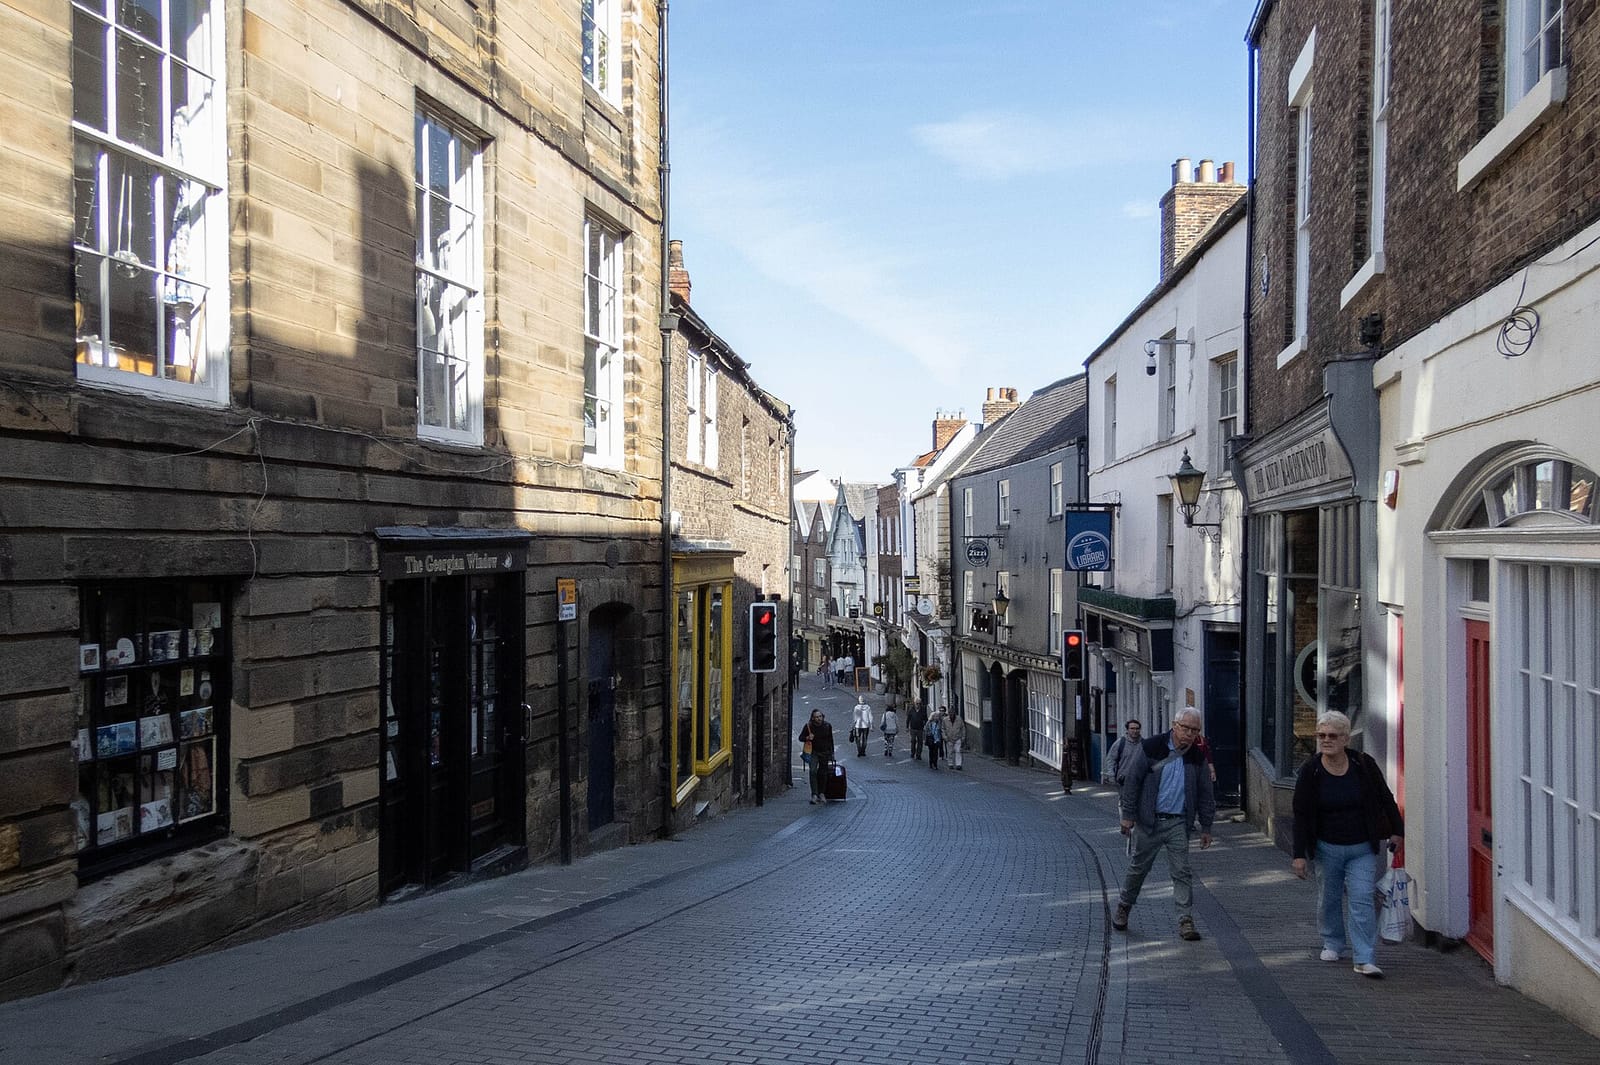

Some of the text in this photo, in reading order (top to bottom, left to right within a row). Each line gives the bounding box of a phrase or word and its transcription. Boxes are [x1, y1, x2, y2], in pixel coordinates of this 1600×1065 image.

[405, 552, 498, 575] The Georgian Window
[1077, 550, 1105, 566] LIBRARY
